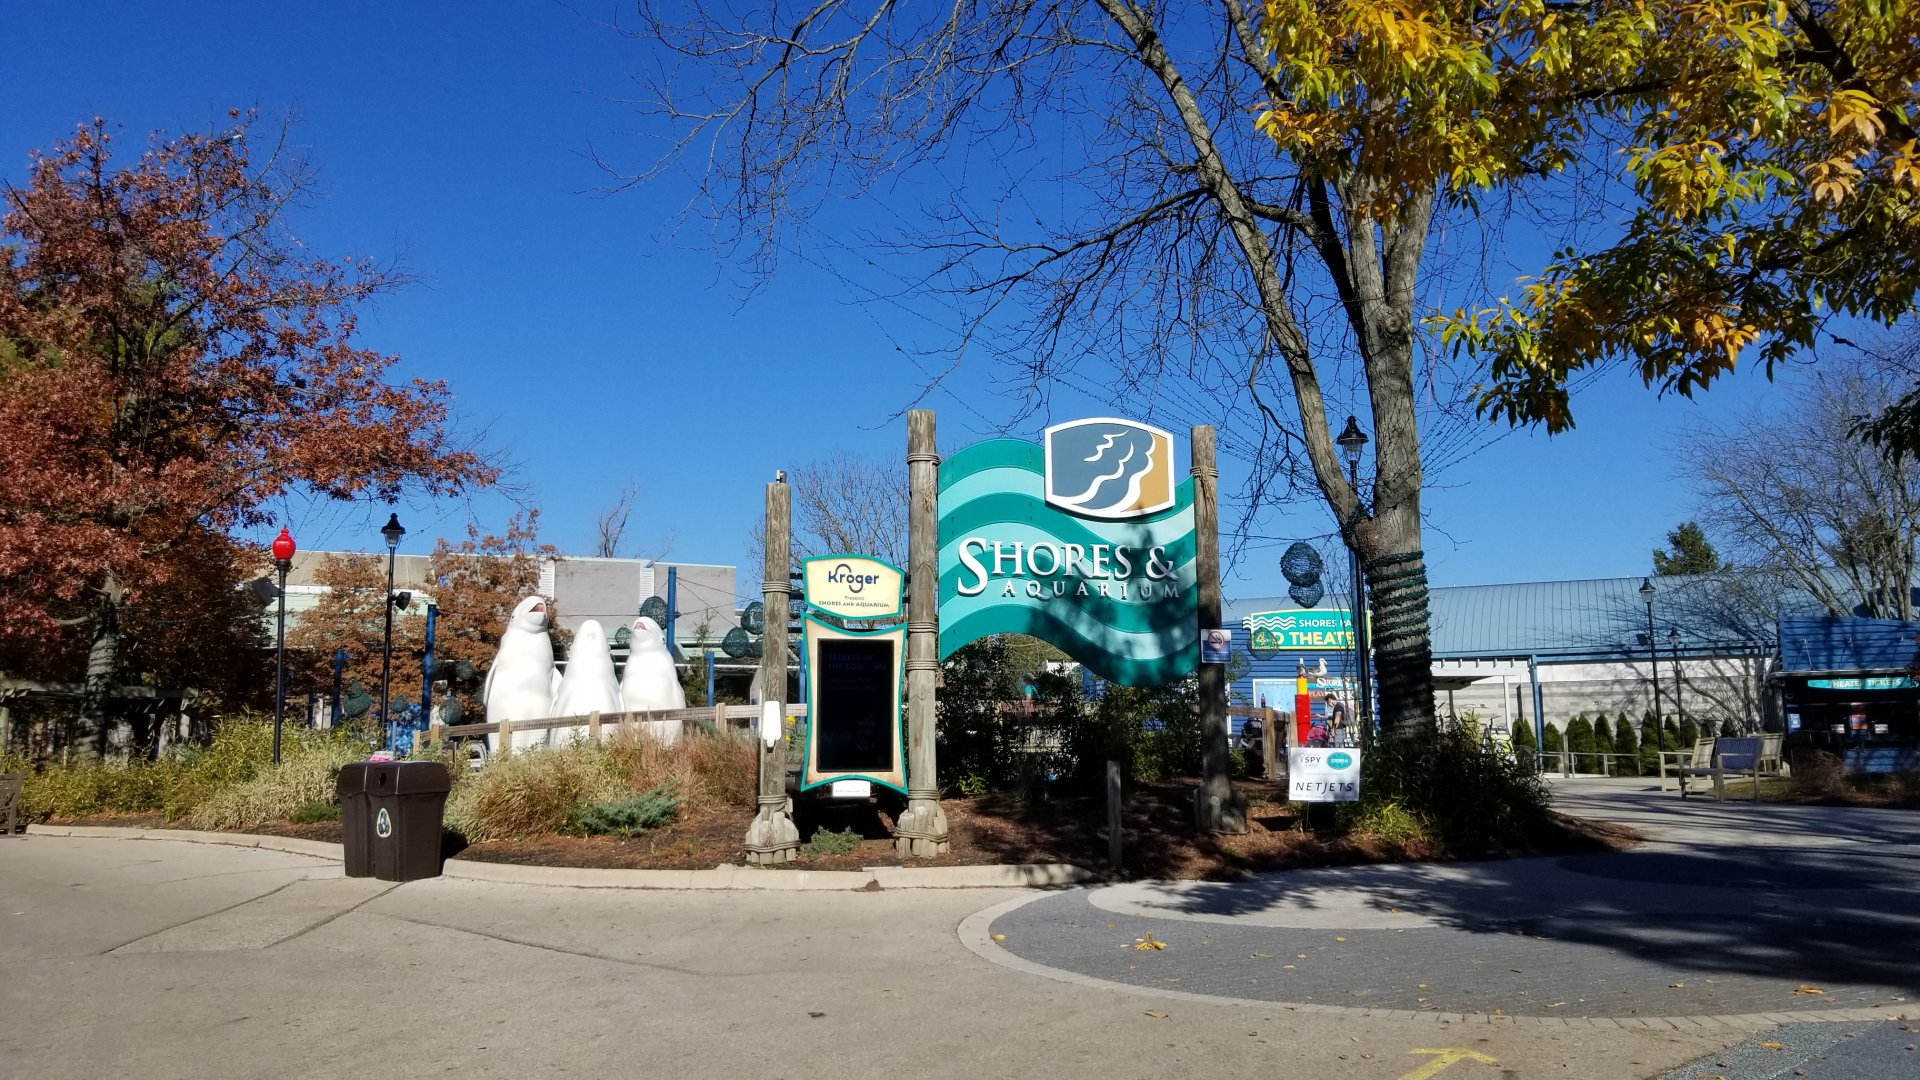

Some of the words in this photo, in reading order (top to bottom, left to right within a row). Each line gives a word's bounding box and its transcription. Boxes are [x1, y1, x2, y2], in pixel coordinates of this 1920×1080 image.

[957, 537, 1132, 595] SHORES
[1145, 545, 1179, 580] &
[828, 563, 879, 594] Kroger
[1002, 580, 1180, 600] AQUARIUM
[1298, 619, 1336, 628] SHORES
[1288, 631, 1355, 646] THEATE
[1296, 782, 1353, 794] NETJETS
